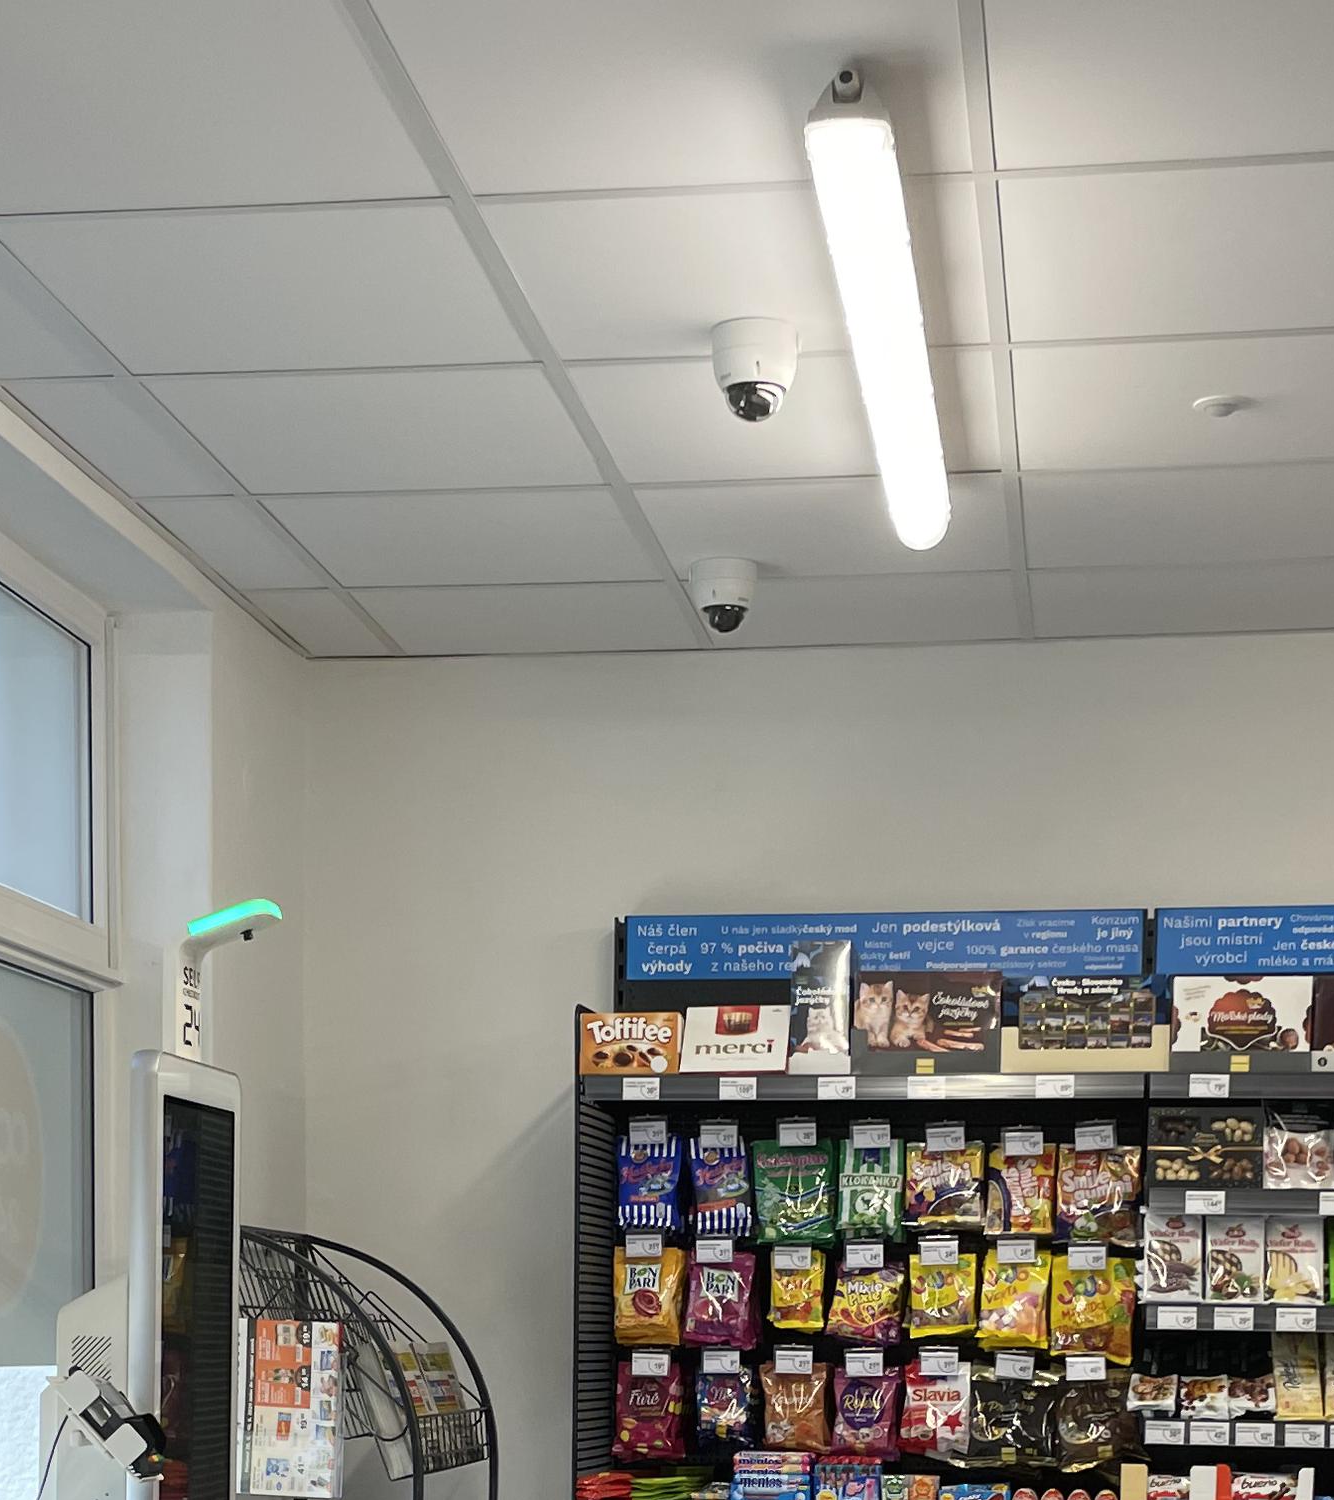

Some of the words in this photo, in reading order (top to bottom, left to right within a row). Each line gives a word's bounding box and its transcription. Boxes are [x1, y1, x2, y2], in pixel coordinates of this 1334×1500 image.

[872, 921, 898, 934] Jen
[902, 918, 1001, 936] podestýlková
[1091, 914, 1140, 926] Konzum
[1162, 915, 1213, 930] Našimi
[1217, 915, 1284, 931] partnery
[637, 924, 663, 937] Náš
[667, 922, 698, 937] člen
[721, 925, 729, 935] U
[731, 925, 750, 935] nás
[751, 925, 768, 937] jen
[802, 923, 832, 937] český
[1096, 927, 1109, 941] je
[1110, 927, 1134, 941] jiný
[647, 941, 687, 957] čerpá
[721, 942, 734, 954] %
[737, 941, 784, 957] pečiva
[916, 939, 955, 954] vejce
[999, 942, 1049, 957] garance
[1051, 941, 1103, 955] českého
[1105, 943, 1140, 954] masa
[1179, 933, 1212, 950] jsou
[1216, 932, 1264, 946] místní
[1273, 940, 1297, 952] Jen
[641, 959, 692, 975] výhody
[711, 961, 718, 971] z
[723, 958, 774, 972] našeho
[1195, 951, 1248, 968] výrobci
[1257, 955, 1298, 968] mléko
[1302, 957, 1310, 967] a
[586, 1016, 673, 1046] Toffifee
[694, 1037, 775, 1057] merci
[911, 1386, 963, 1402] Slavia
[1240, 1477, 1279, 1491] bueno
